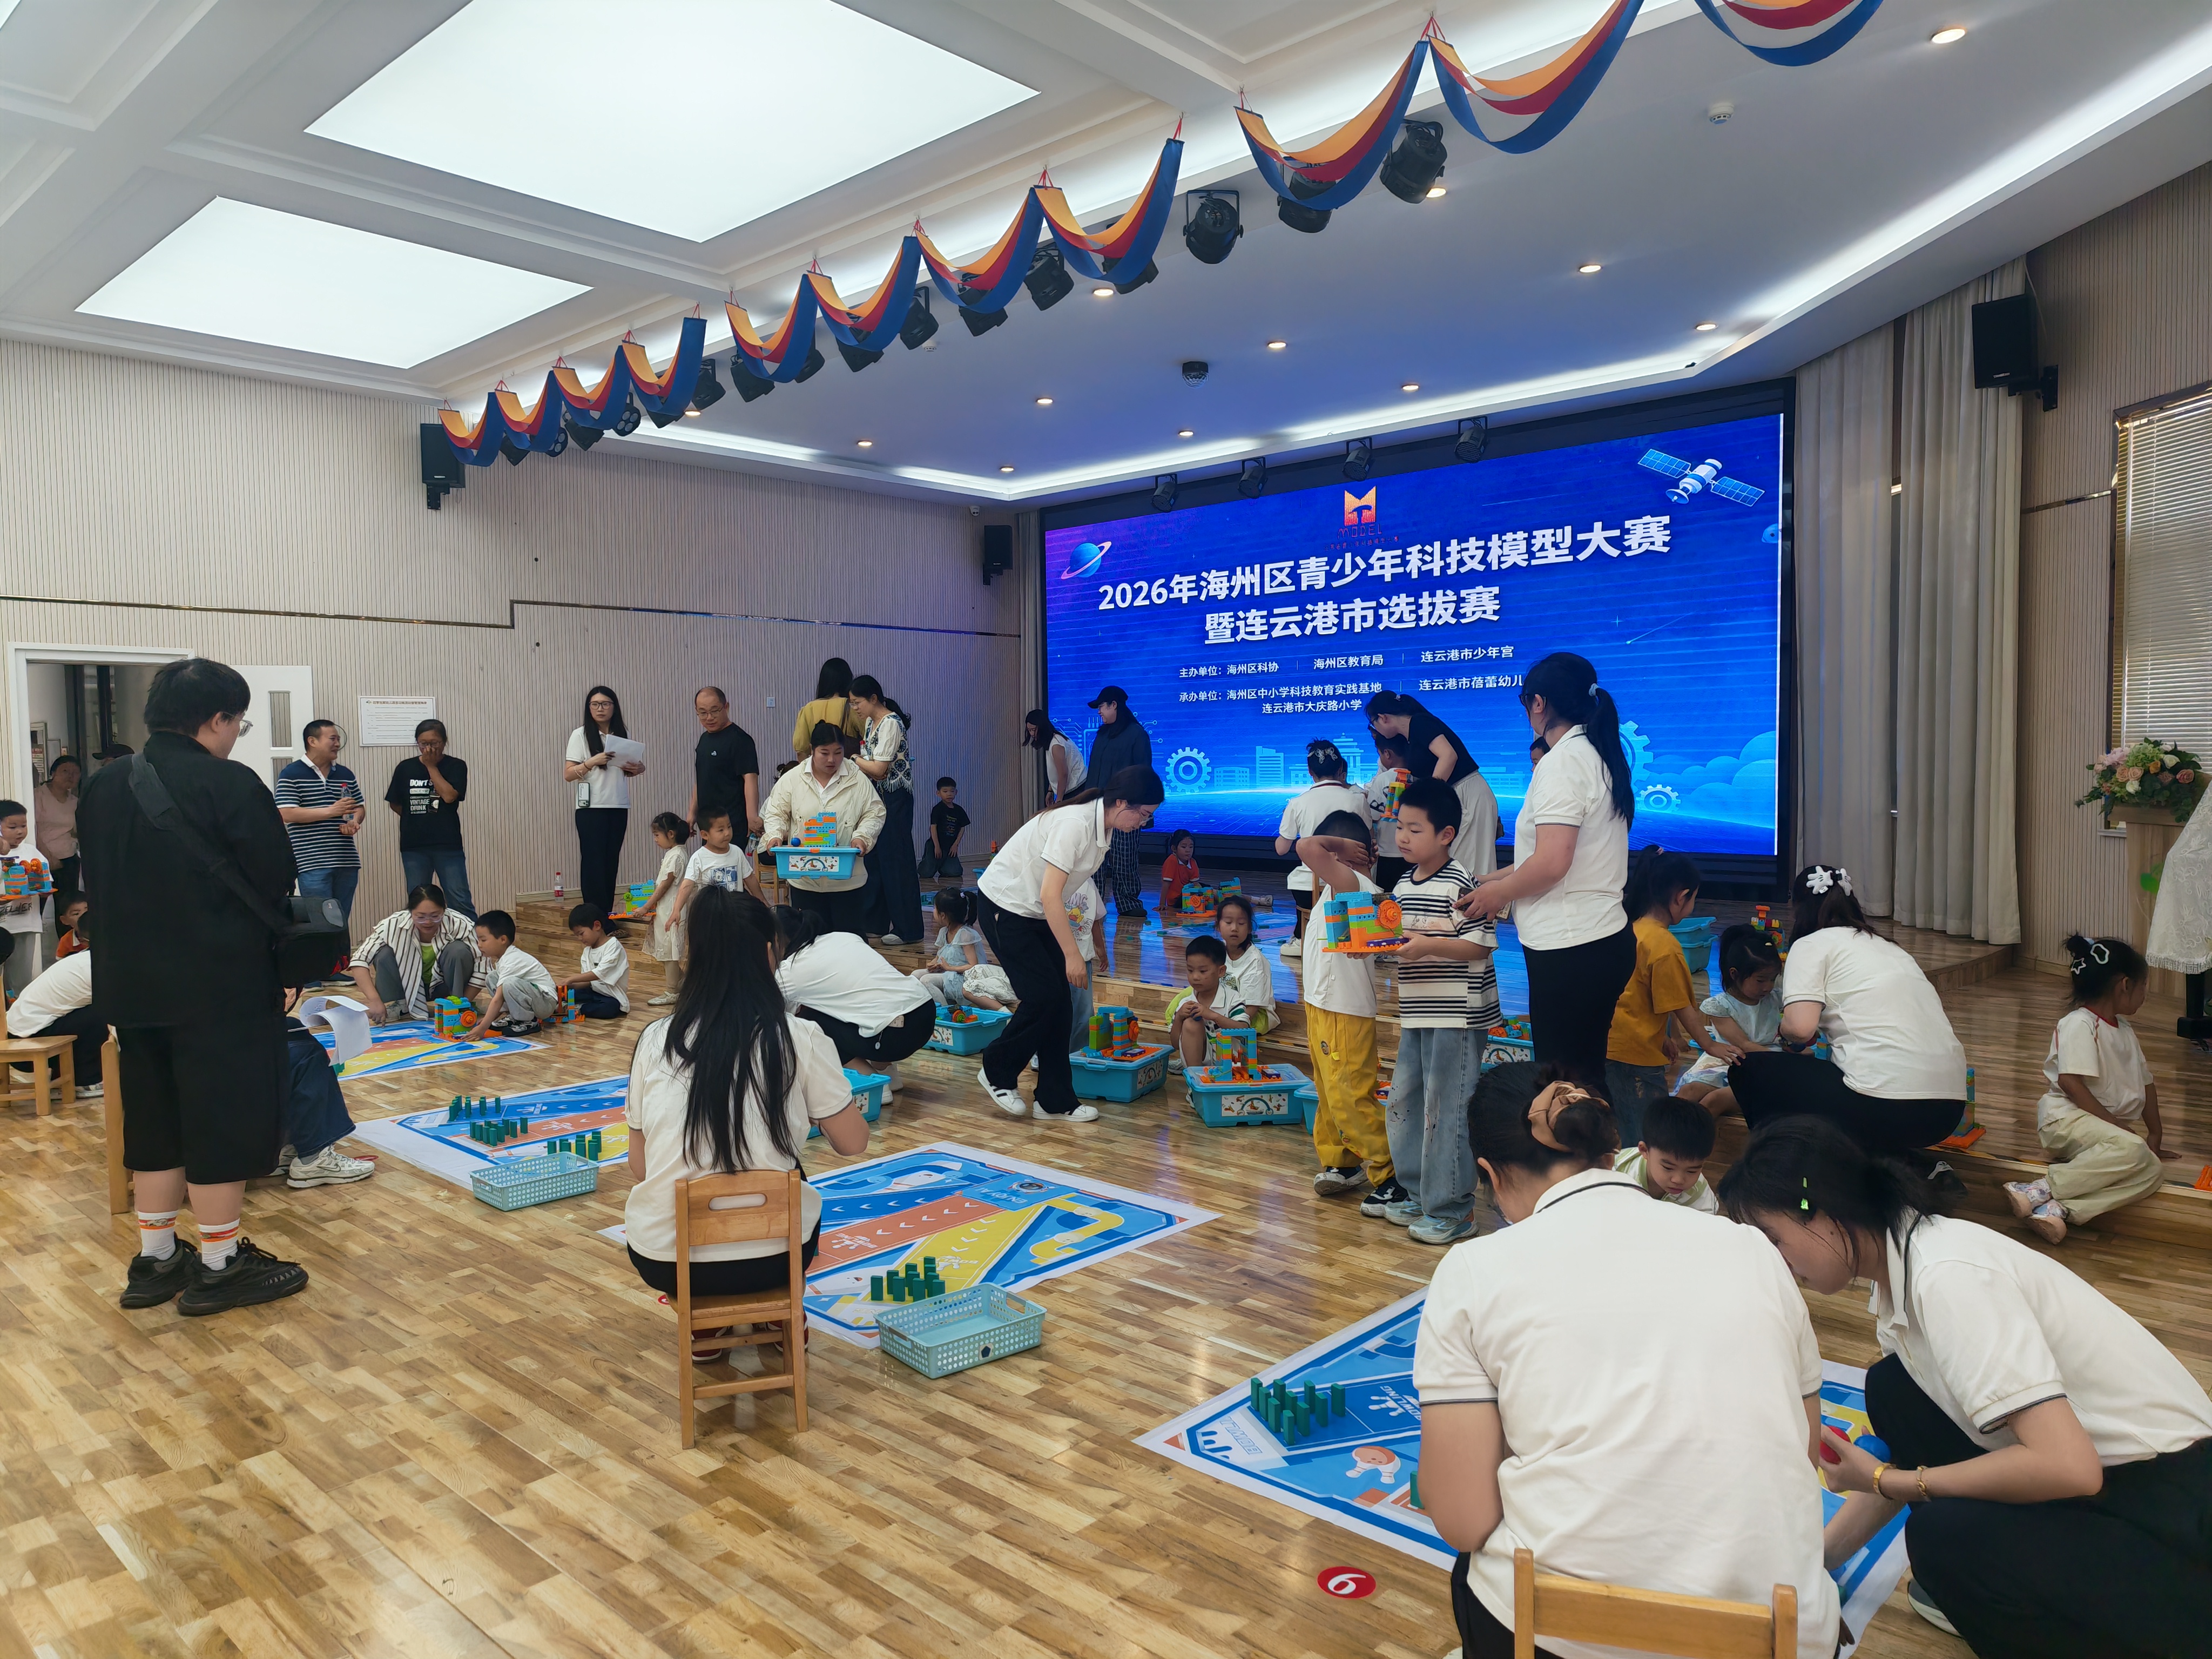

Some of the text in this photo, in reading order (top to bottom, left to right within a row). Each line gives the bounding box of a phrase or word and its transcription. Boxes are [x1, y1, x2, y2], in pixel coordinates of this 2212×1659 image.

[1337, 524, 1382, 539] MODEL
[1098, 515, 1672, 610] 2026年海州区青少年科技模型大赛
[1204, 585, 1501, 645] 暨连云港市选拔赛
[1313, 654, 1384, 670] 海州区教育局
[1420, 645, 1514, 663] 连云港市少年宫
[1262, 698, 1363, 714] 连云港市大庆路小学
[988, 1191, 1028, 1204] ENJOY
[835, 1232, 878, 1249] BOWLING
